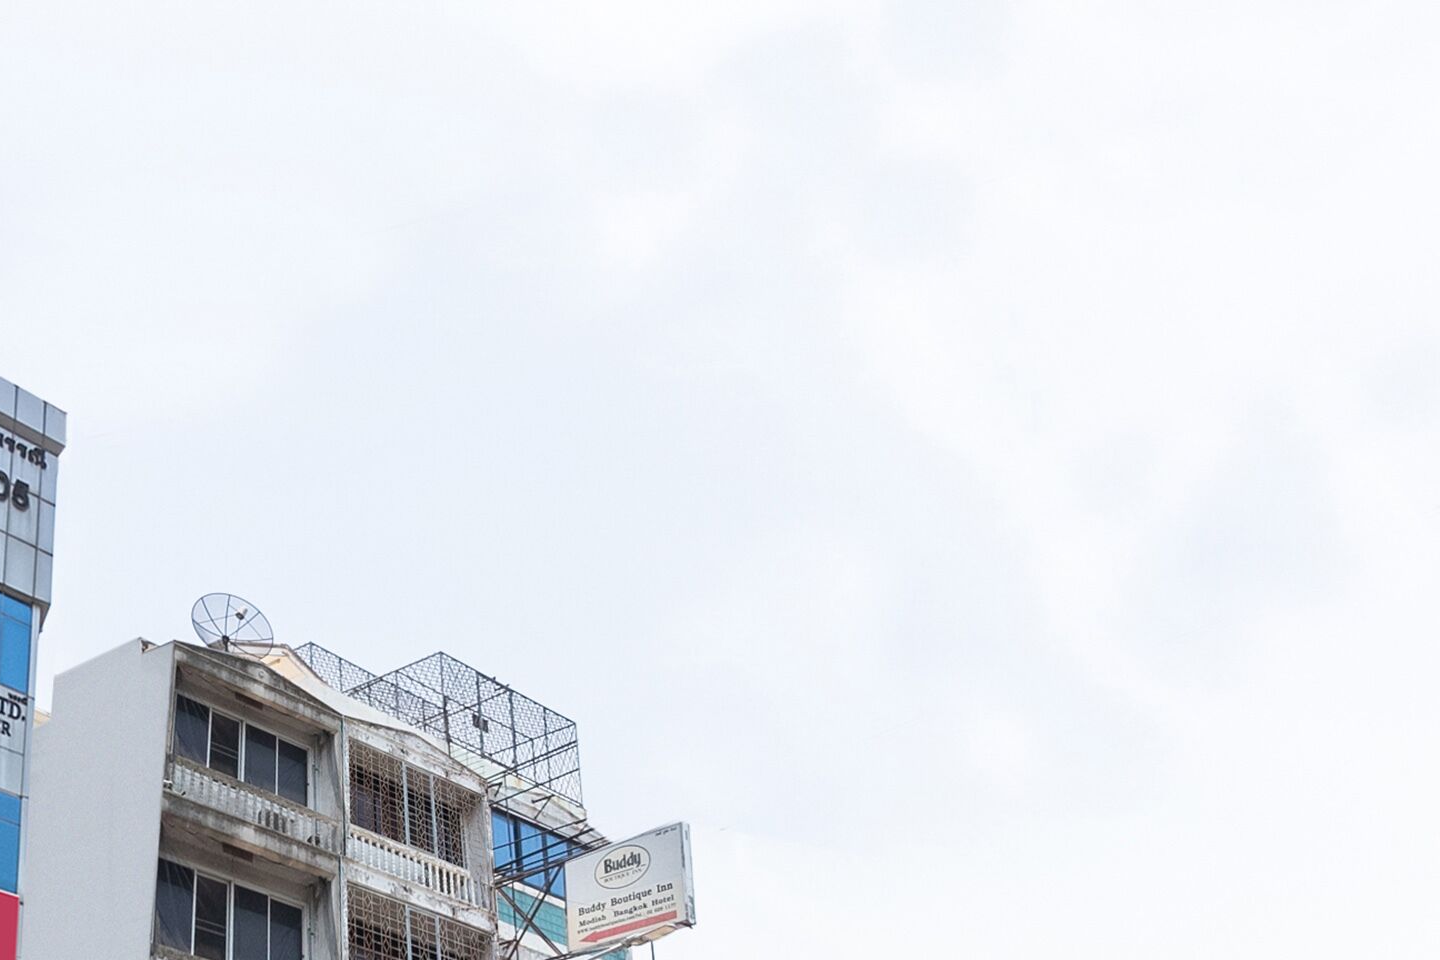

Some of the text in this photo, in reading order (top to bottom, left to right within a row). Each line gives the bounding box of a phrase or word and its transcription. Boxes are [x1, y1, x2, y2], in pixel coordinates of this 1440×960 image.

[603, 851, 642, 875] Buddy
[578, 882, 673, 916] Buddy Boutique Inn
[613, 902, 648, 918] Bangkok
[651, 894, 675, 907] Hotel
